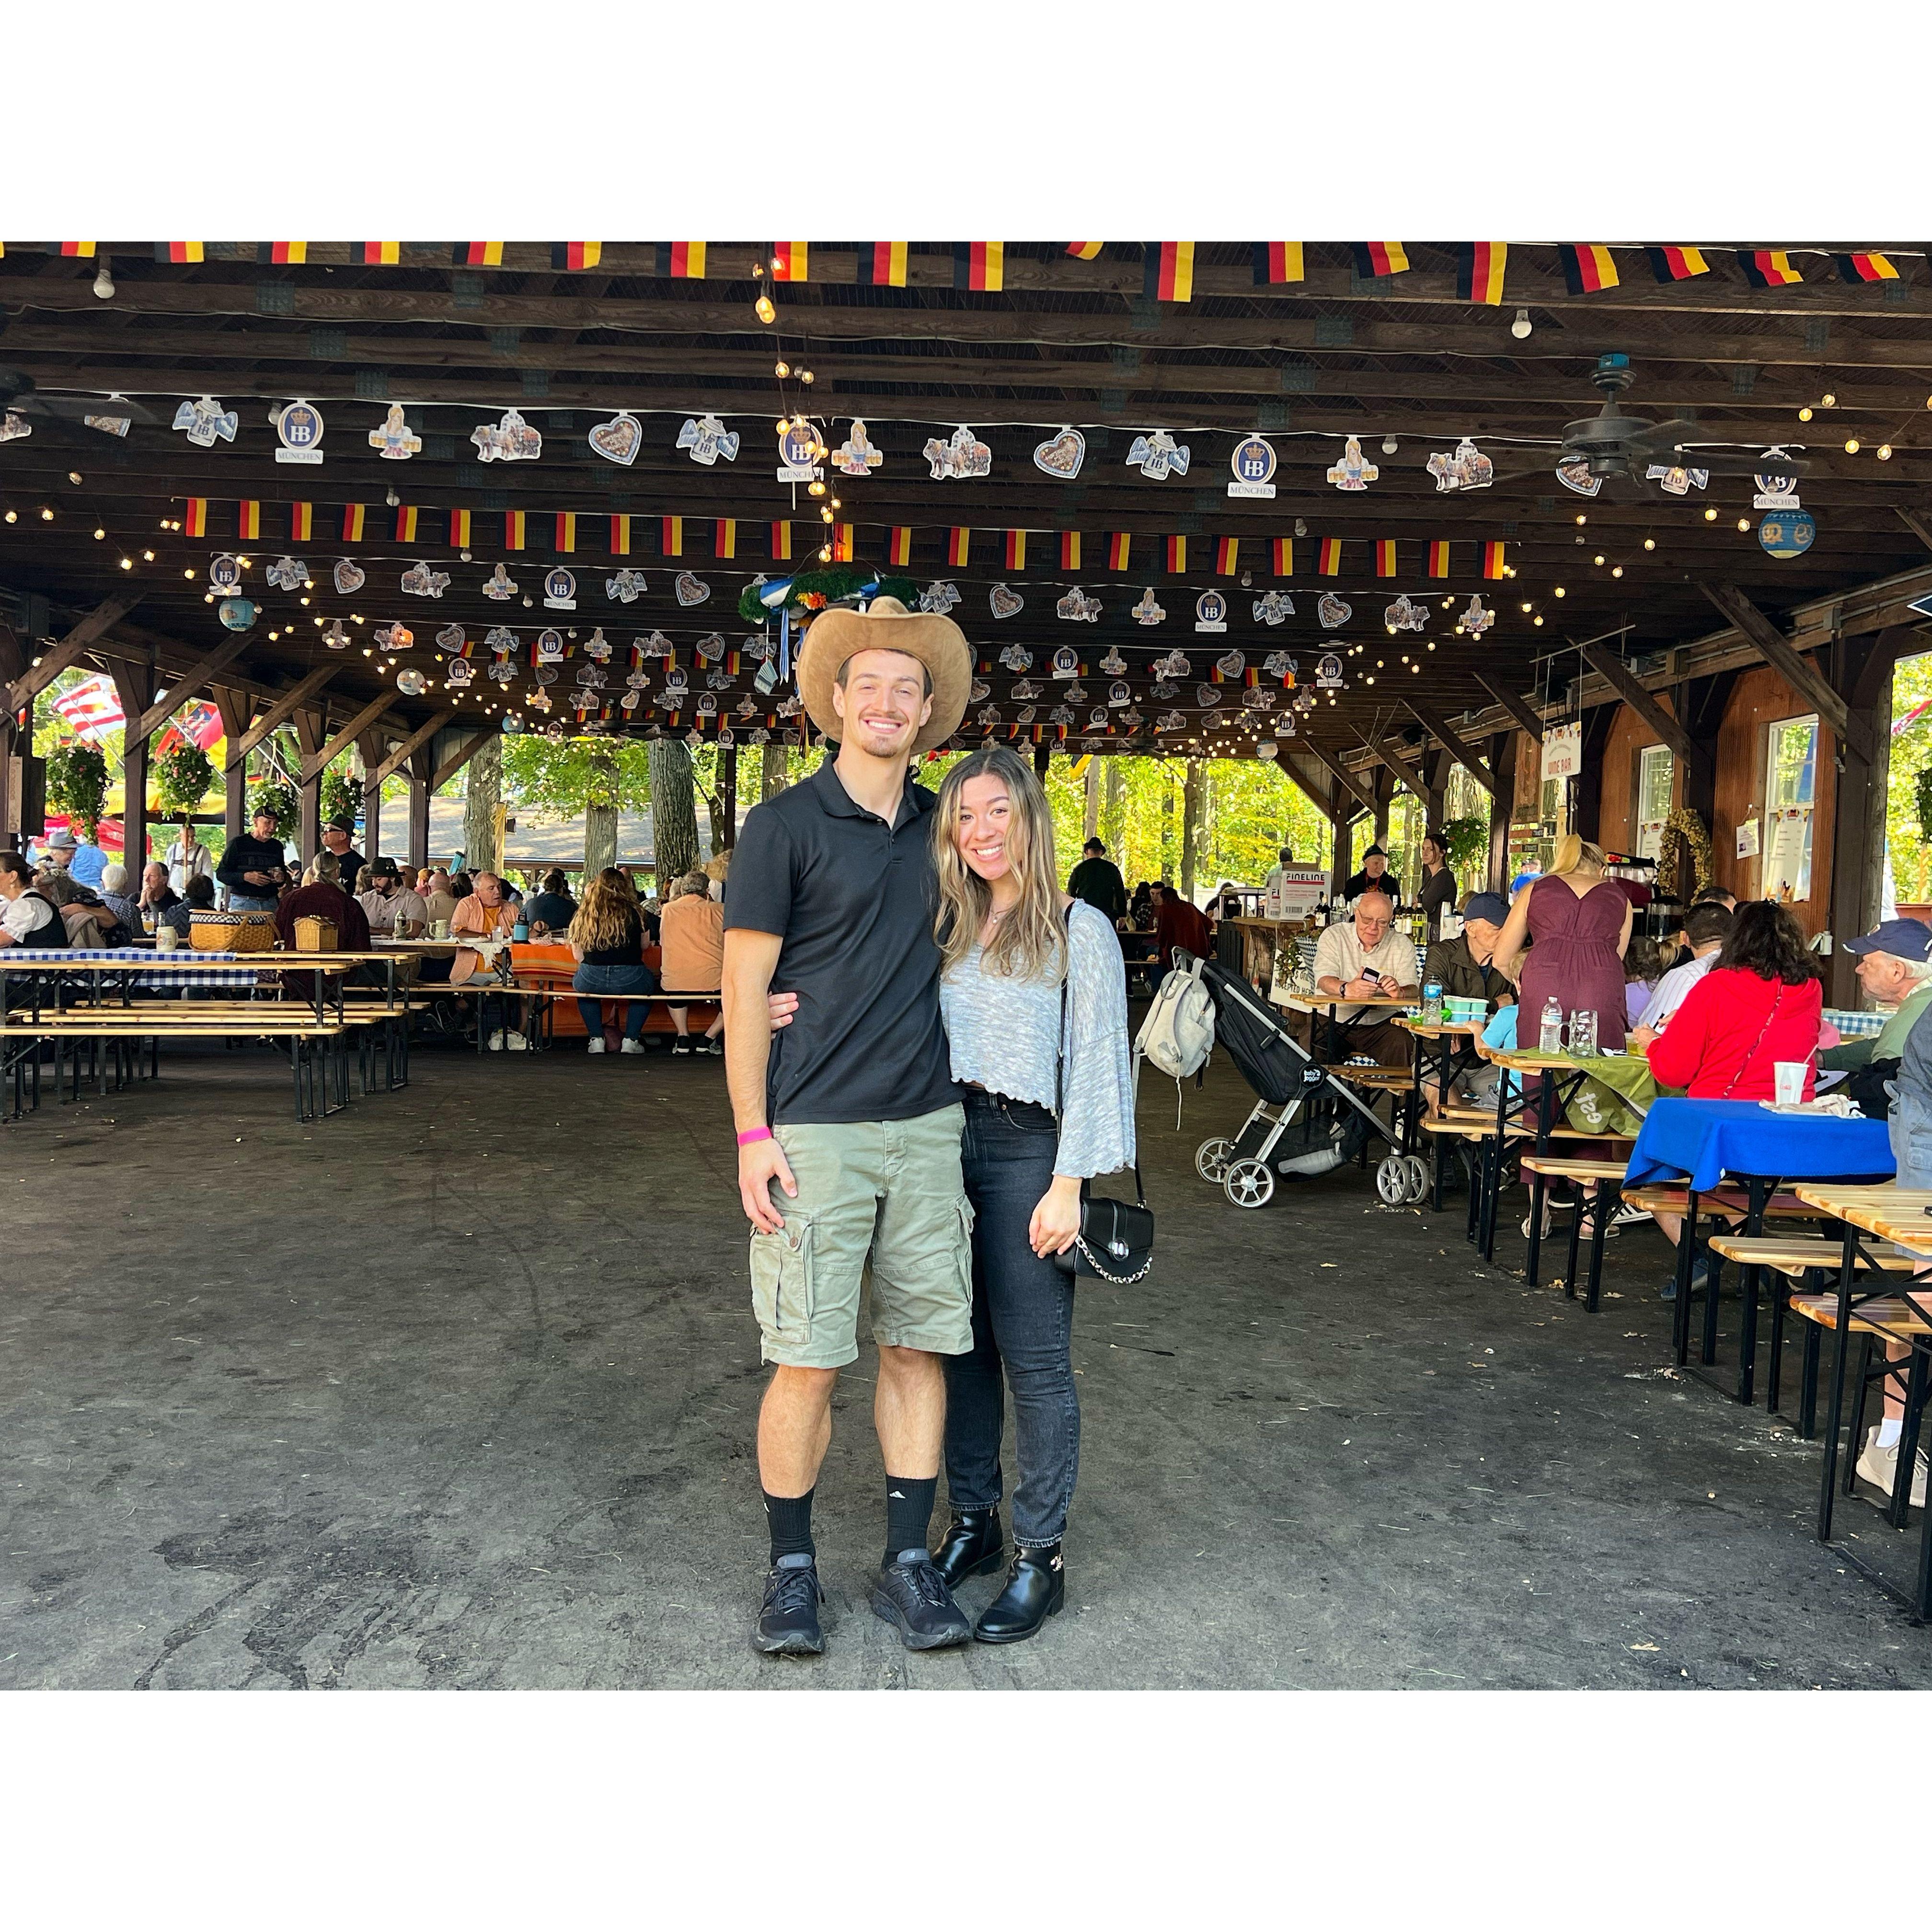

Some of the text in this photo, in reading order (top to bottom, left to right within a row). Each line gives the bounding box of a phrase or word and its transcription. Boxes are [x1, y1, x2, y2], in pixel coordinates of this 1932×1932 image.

[198, 424, 209, 436] HB
[291, 426, 311, 442] HB
[699, 442, 711, 454] HB
[792, 444, 812, 461] HB
[278, 451, 321, 461] MÜNCHEN
[1244, 460, 1264, 477] HB
[1230, 486, 1274, 495] MÜNCHEN
[219, 571, 232, 582] HB
[554, 584, 567, 595] HB
[1205, 607, 1218, 618] HB
[545, 642, 556, 651] HB
[1060, 658, 1071, 668] HB
[455, 668, 464, 677] HB
[1325, 667, 1336, 676] HB
[672, 677, 682, 685] HB
[1561, 757, 1571, 773] BAR
[1286, 873, 1325, 881] FINELINE
